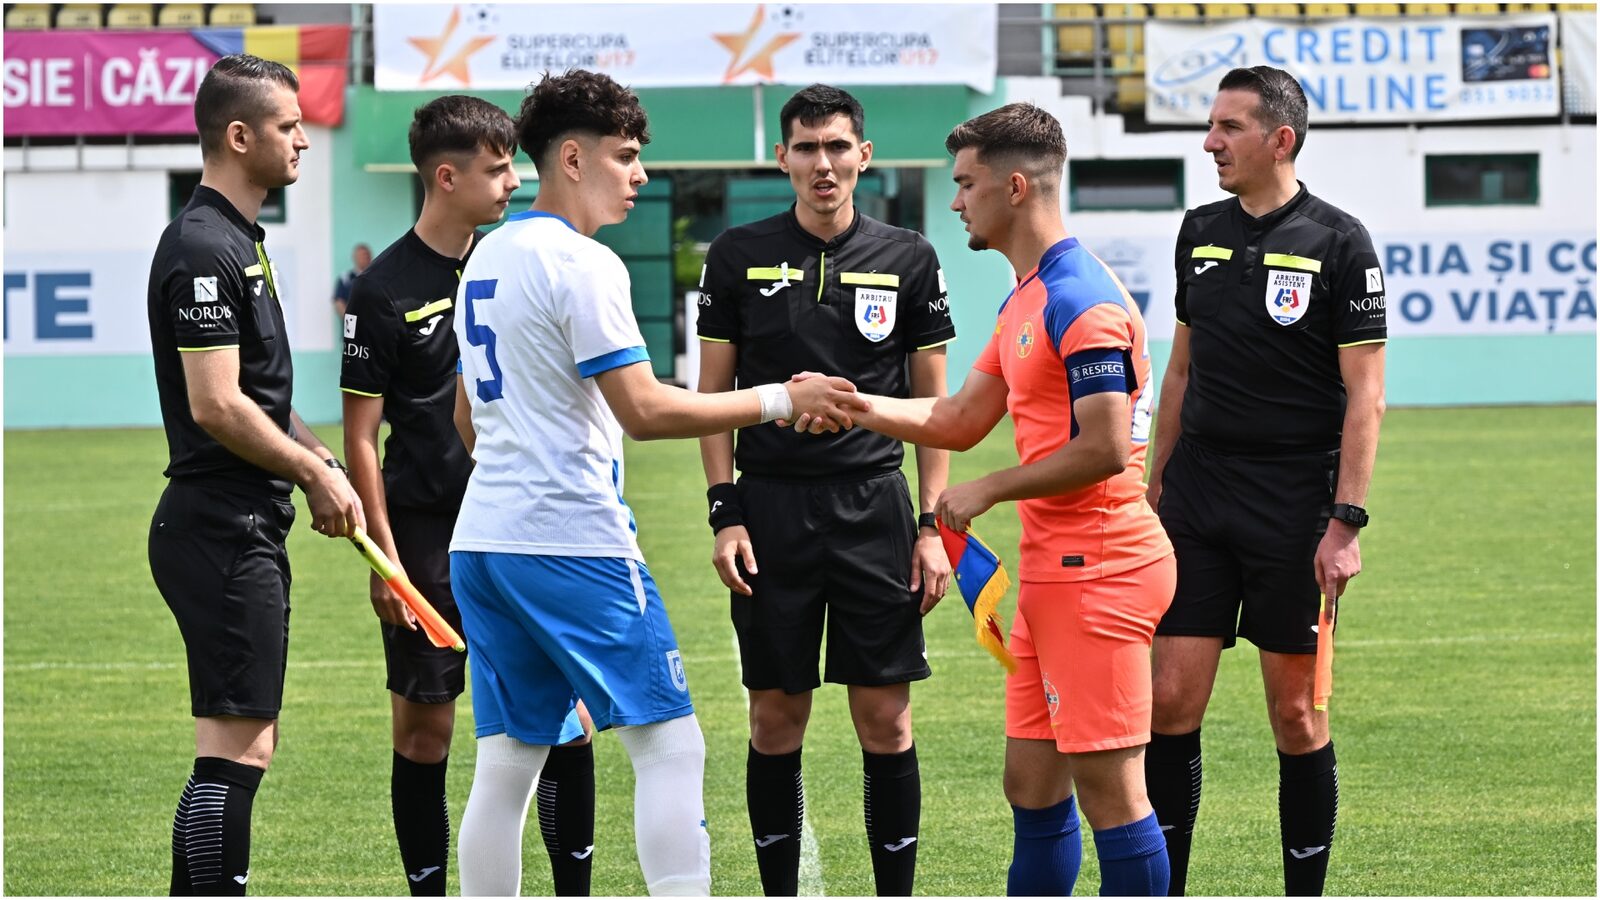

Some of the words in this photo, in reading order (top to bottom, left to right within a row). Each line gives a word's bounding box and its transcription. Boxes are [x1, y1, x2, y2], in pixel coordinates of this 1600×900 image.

[507, 33, 628, 50] SUPERCUPA
[811, 32, 931, 48] SUPERCUPA
[1263, 26, 1444, 64] CREDIT
[4, 58, 75, 107] SIE
[1385, 243, 1469, 275] RIA
[1273, 280, 1306, 289] ASISTENT
[1275, 274, 1305, 283] ARBITRU
[861, 293, 893, 302] ARBITRU
[178, 305, 232, 321] NORDIS
[1400, 290, 1434, 324] O
[465, 279, 504, 404] 5
[344, 343, 370, 359] DIS
[1082, 364, 1124, 377] RESPECT
